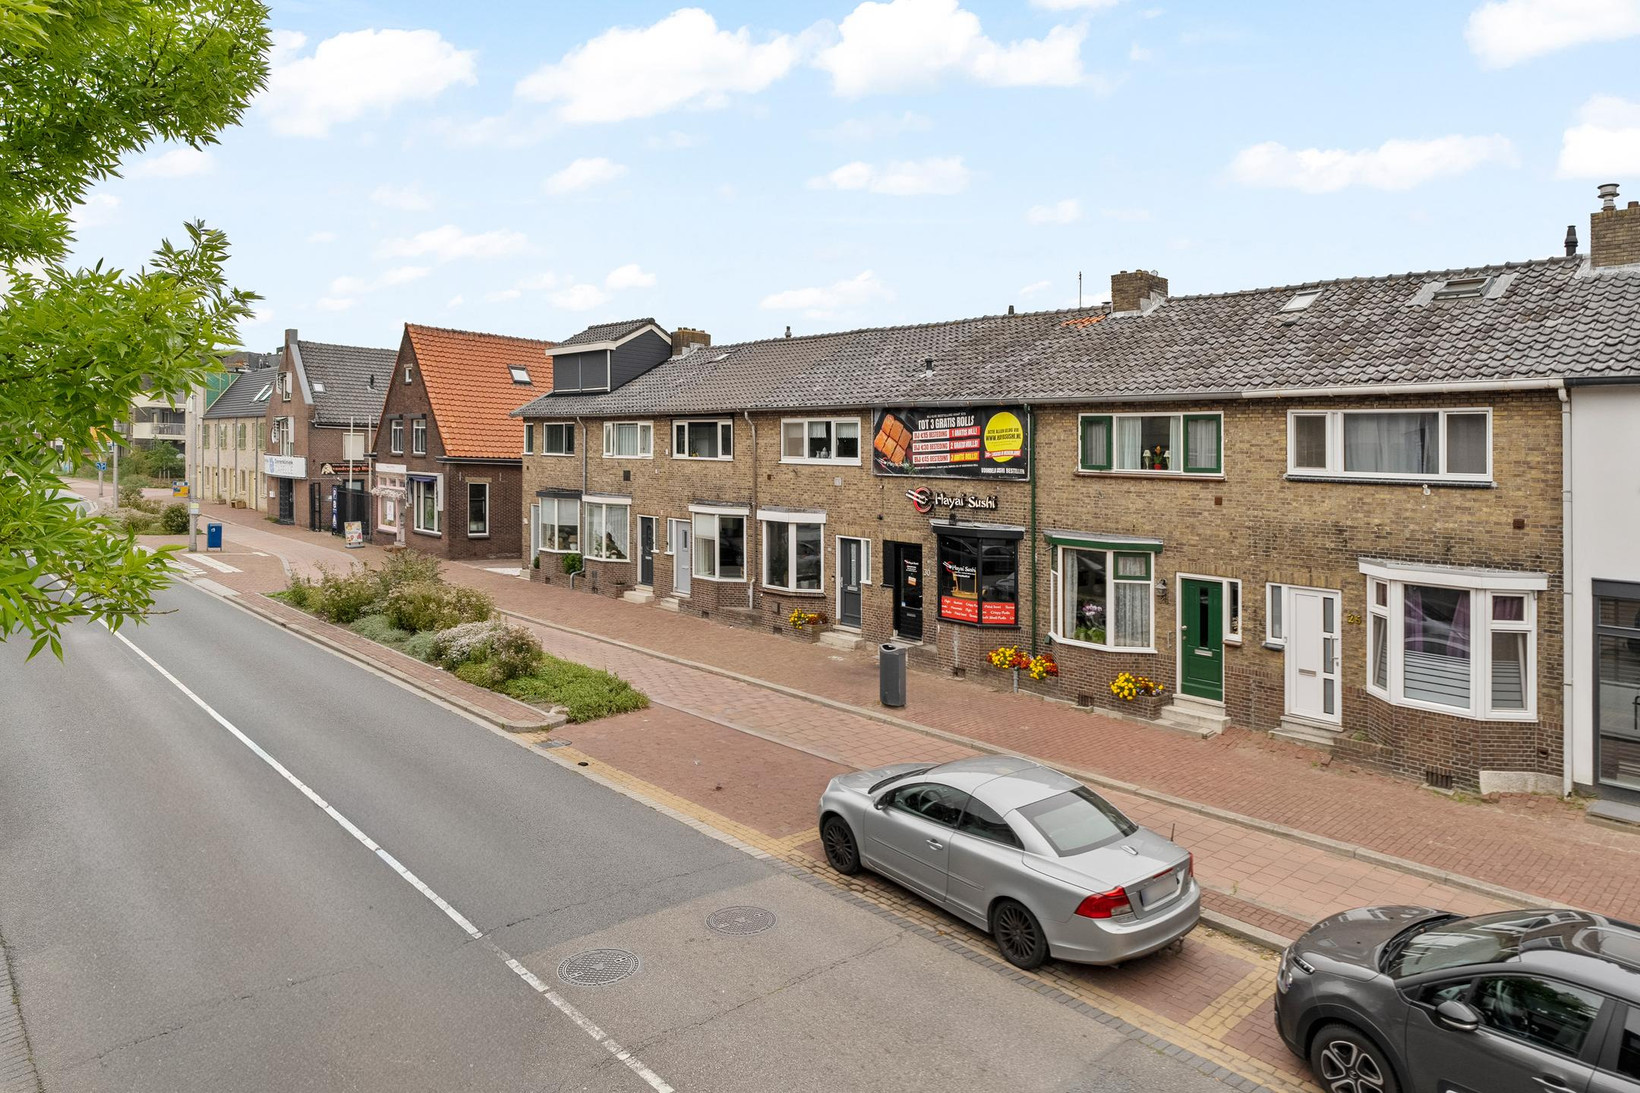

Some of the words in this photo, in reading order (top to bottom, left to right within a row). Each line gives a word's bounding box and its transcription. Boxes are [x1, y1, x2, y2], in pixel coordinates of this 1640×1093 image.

[918, 419, 930, 430] TOT
[930, 418, 935, 429] 3
[935, 416, 956, 429] GRATIS
[956, 415, 975, 427] ROLLS
[935, 492, 965, 509] Hayai
[968, 496, 996, 509] Sushi
